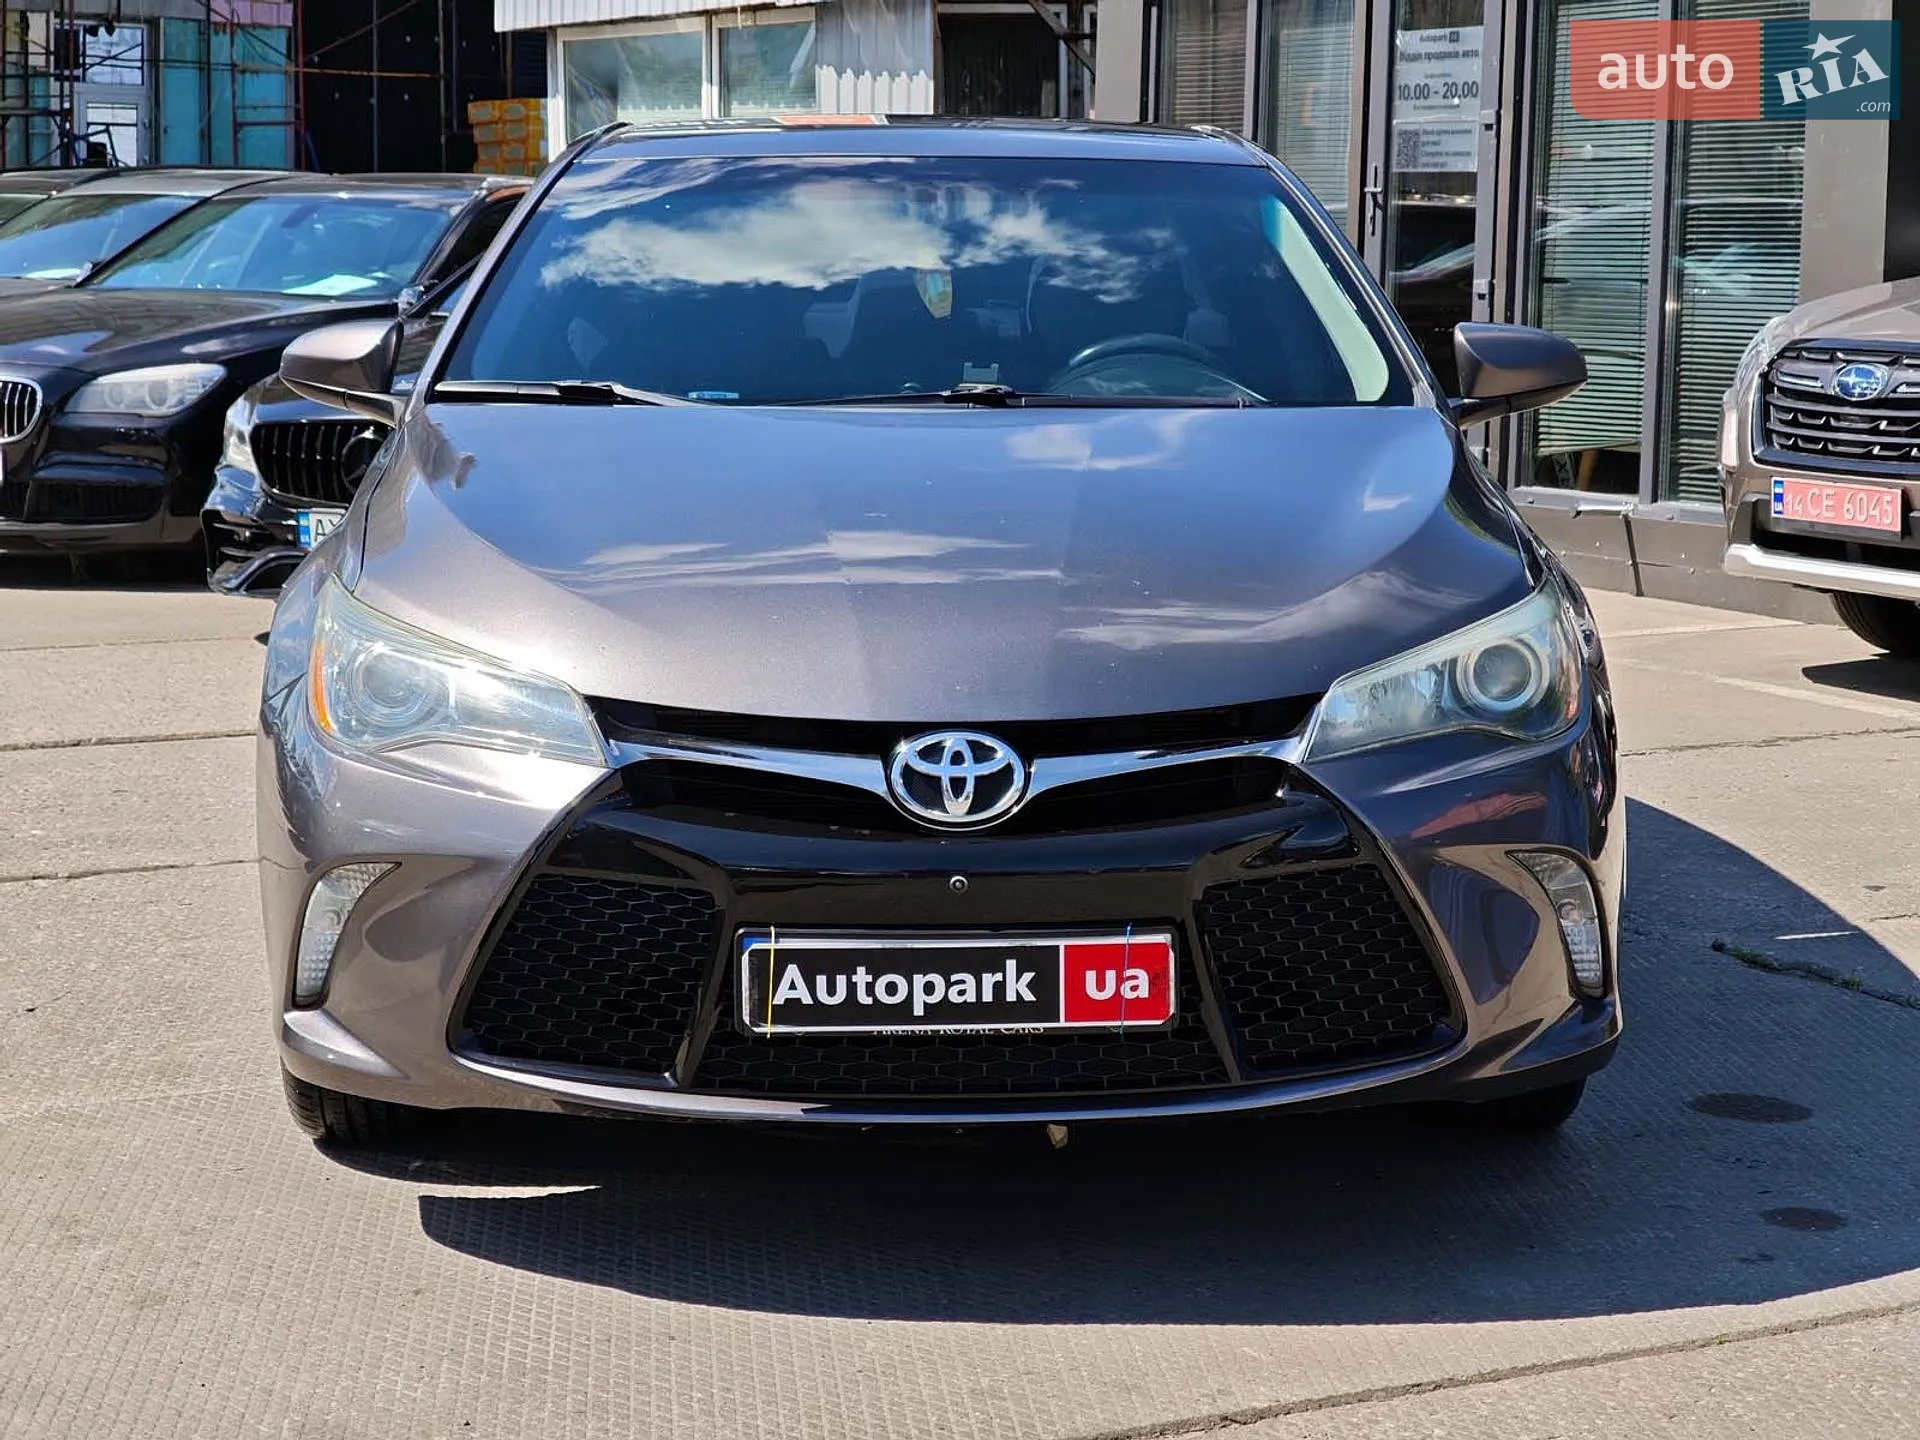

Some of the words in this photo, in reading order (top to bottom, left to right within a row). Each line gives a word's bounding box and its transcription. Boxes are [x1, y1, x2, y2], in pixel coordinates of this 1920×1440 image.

[1398, 82, 1431, 101] 10.00
[1442, 80, 1480, 99] 20.00
[1787, 494, 1803, 515] 14
[1807, 487, 1836, 518] CE
[1843, 491, 1894, 525] 6045
[772, 959, 1037, 1016] Autopark
[1085, 968, 1150, 1000] ua
